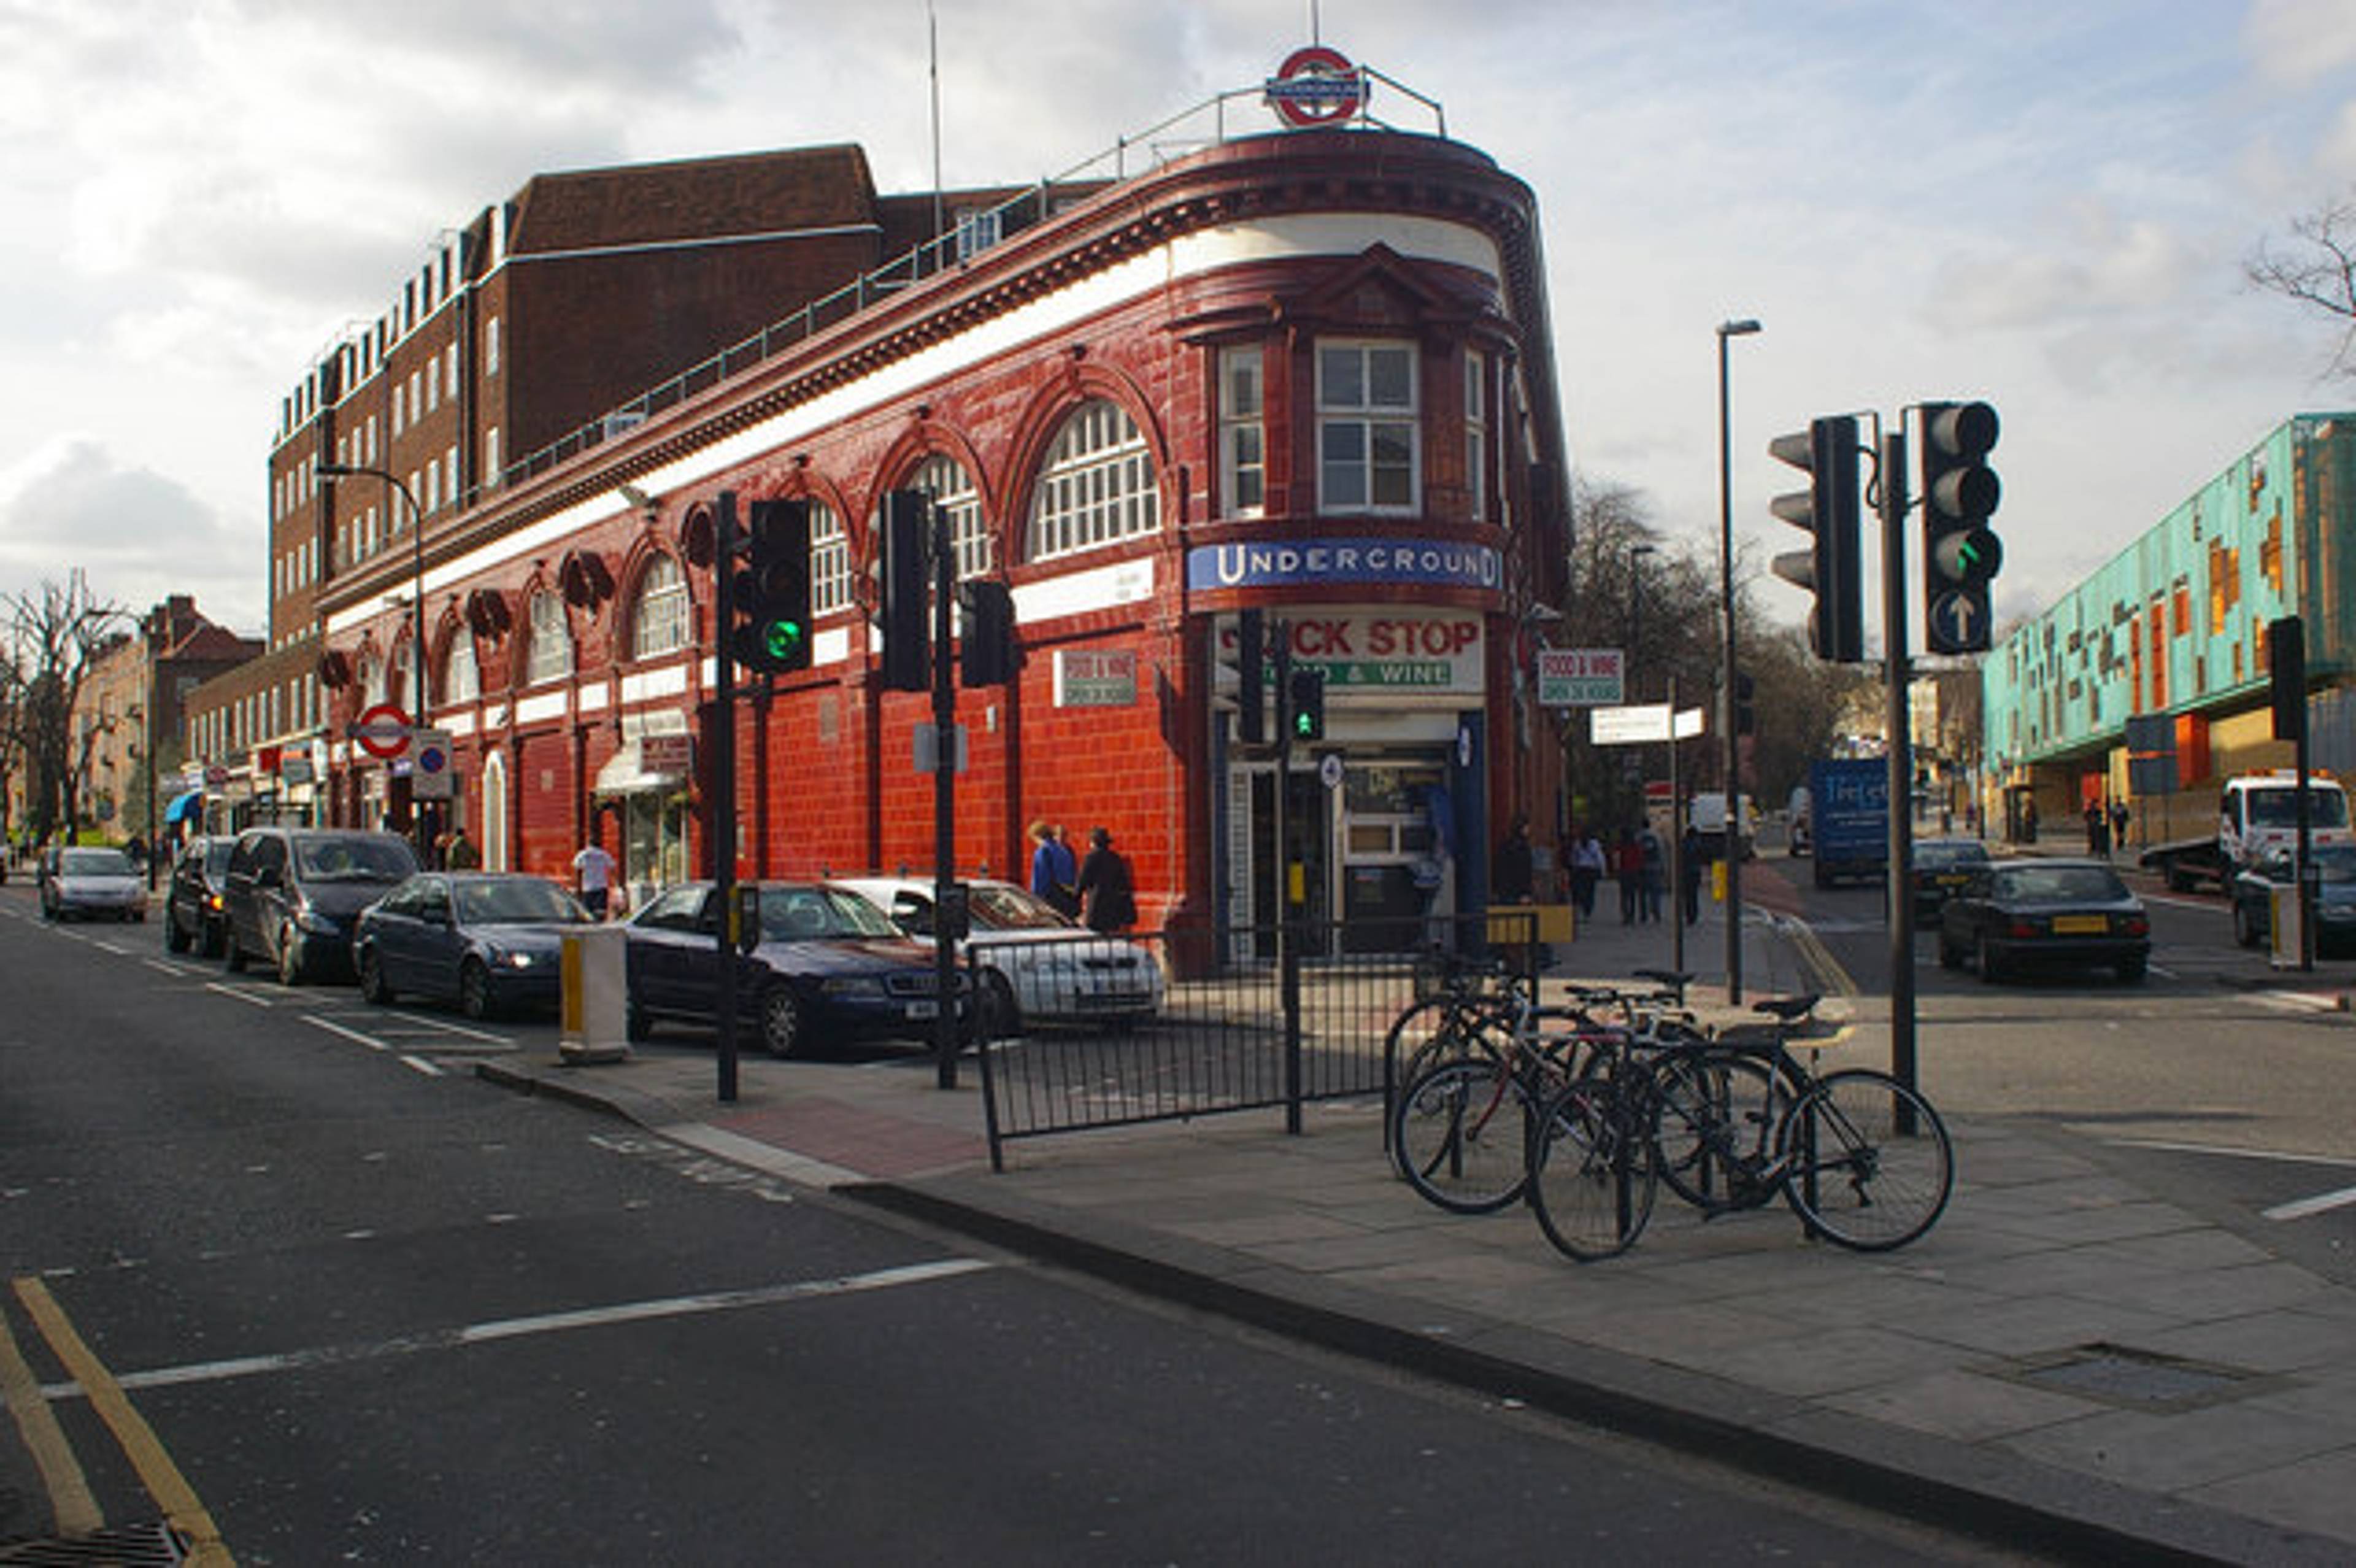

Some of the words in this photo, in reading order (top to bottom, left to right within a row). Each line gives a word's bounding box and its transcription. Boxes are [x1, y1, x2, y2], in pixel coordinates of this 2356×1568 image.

[1217, 544, 1496, 585] UNDERGROUND
[1368, 619, 1477, 656] STOP
[1380, 663, 1449, 683] WINE
[1543, 655, 1574, 675] FOOD
